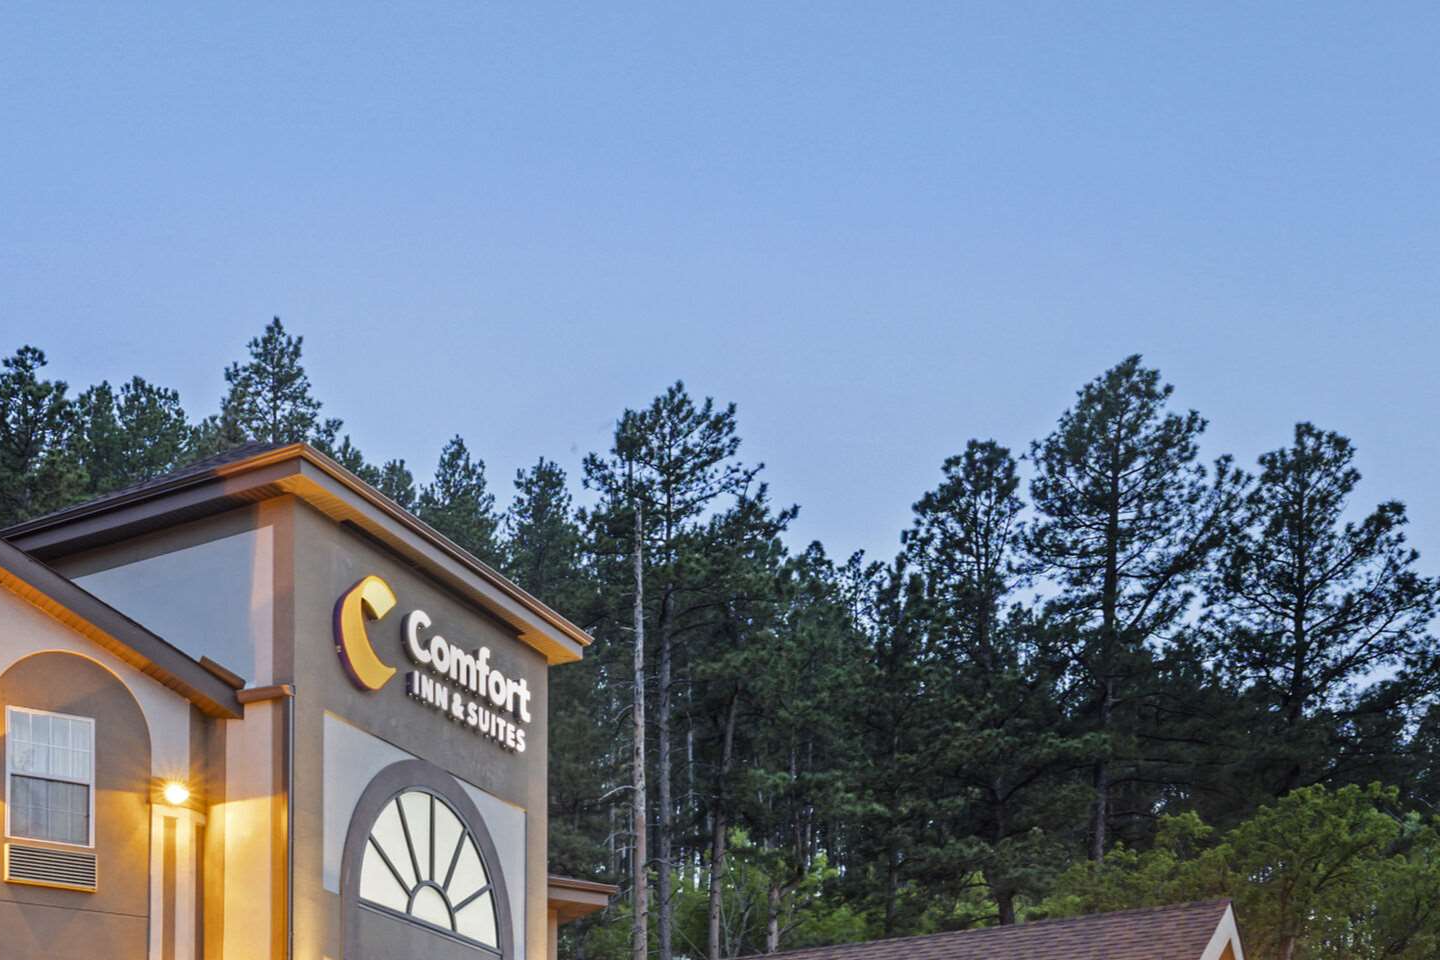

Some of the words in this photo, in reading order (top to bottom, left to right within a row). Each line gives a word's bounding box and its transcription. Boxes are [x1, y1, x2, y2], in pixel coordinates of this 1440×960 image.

[405, 609, 531, 723] Comfort
[412, 670, 449, 711] INN
[451, 692, 465, 721] &
[466, 701, 527, 753] SUITES
